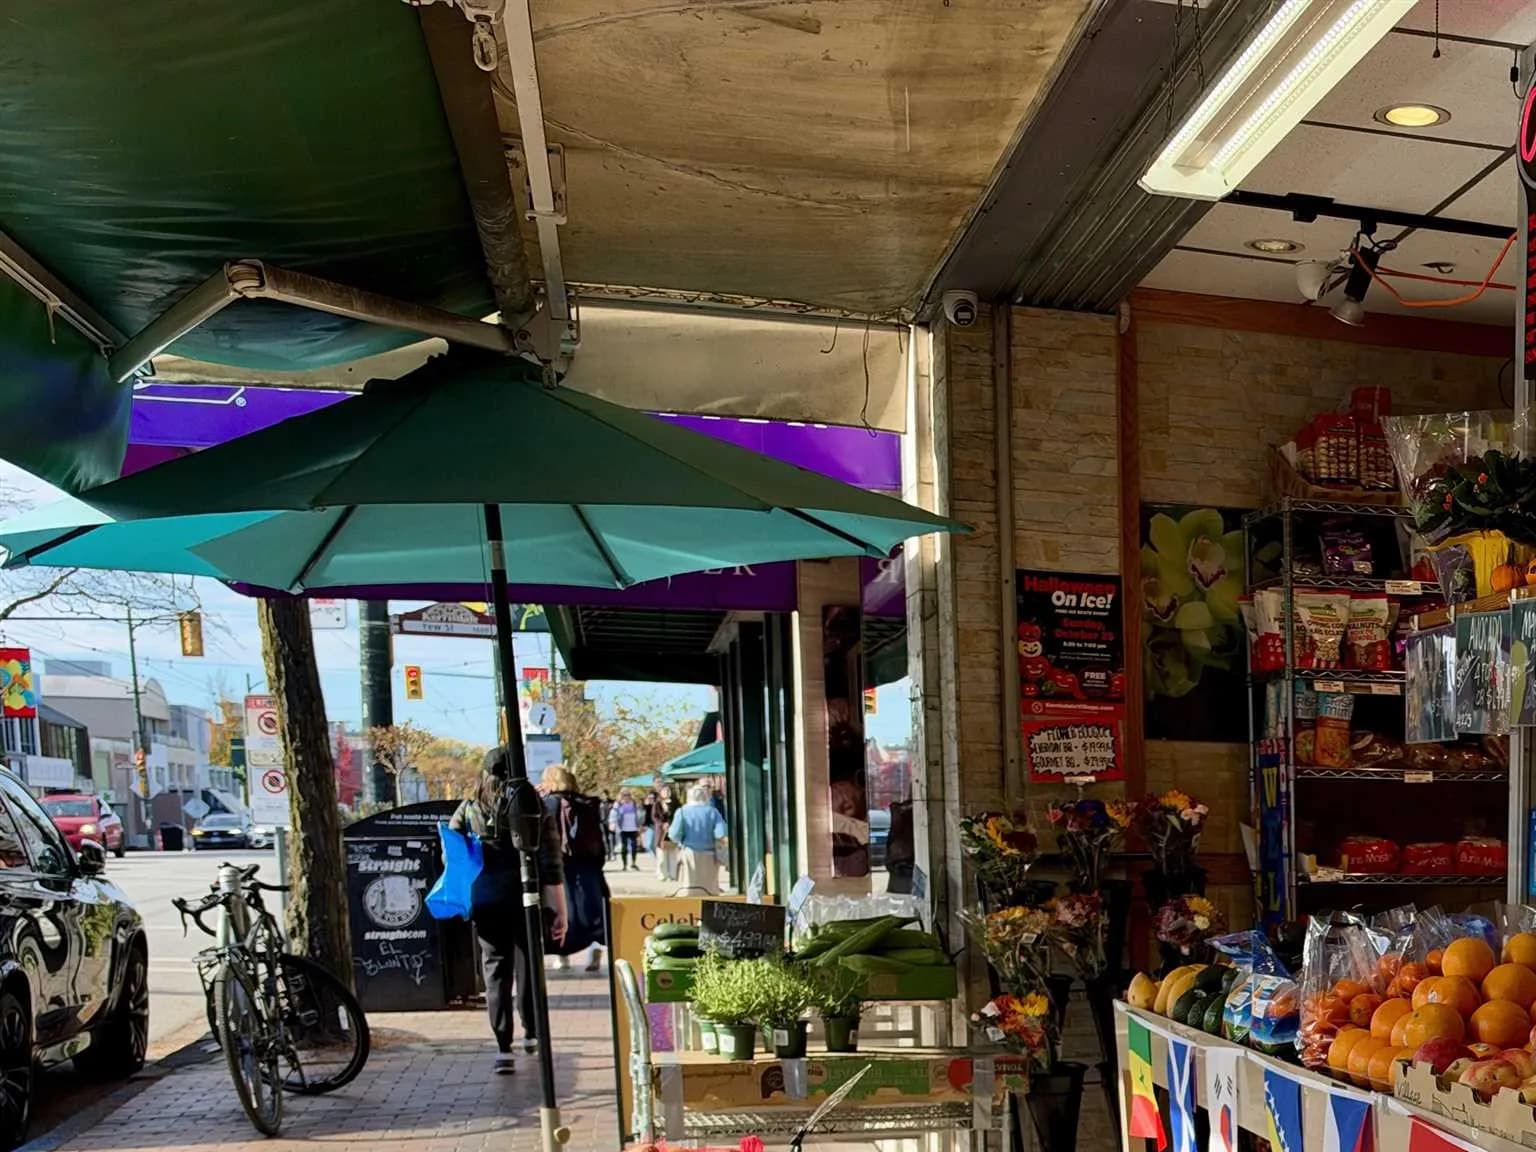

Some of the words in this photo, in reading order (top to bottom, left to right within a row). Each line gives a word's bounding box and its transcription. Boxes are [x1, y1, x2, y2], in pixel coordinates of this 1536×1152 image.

[1051, 590, 1078, 607] On
[1079, 592, 1113, 609] Ice!
[358, 859, 421, 874] straight
